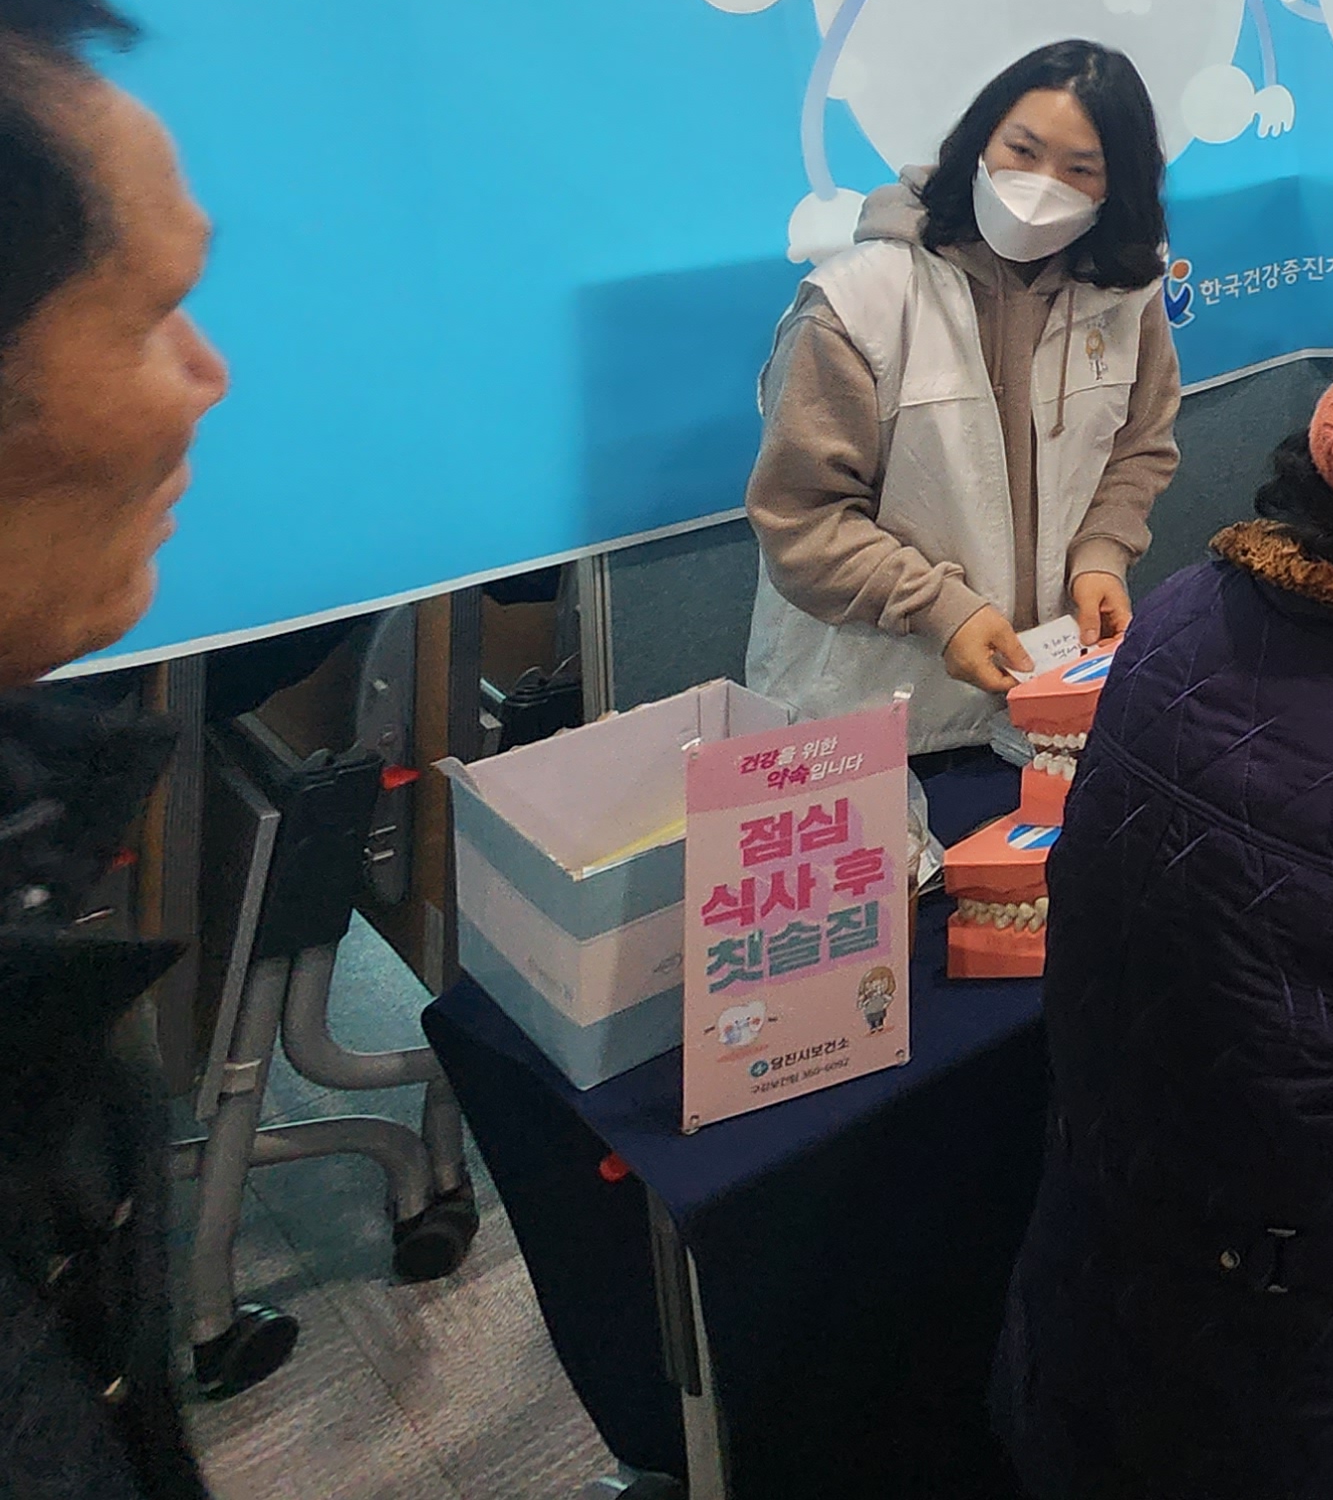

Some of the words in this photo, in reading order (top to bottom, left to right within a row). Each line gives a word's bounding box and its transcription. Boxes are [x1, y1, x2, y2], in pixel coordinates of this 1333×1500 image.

[739, 746, 797, 775] 건강을
[801, 736, 839, 760] 위한
[766, 753, 865, 790] 약속입니다
[739, 797, 849, 868] 점심
[701, 862, 817, 927] 식사
[832, 847, 885, 897] 후
[705, 900, 880, 994] 칫솔질
[770, 1037, 850, 1071] 당진시보건소
